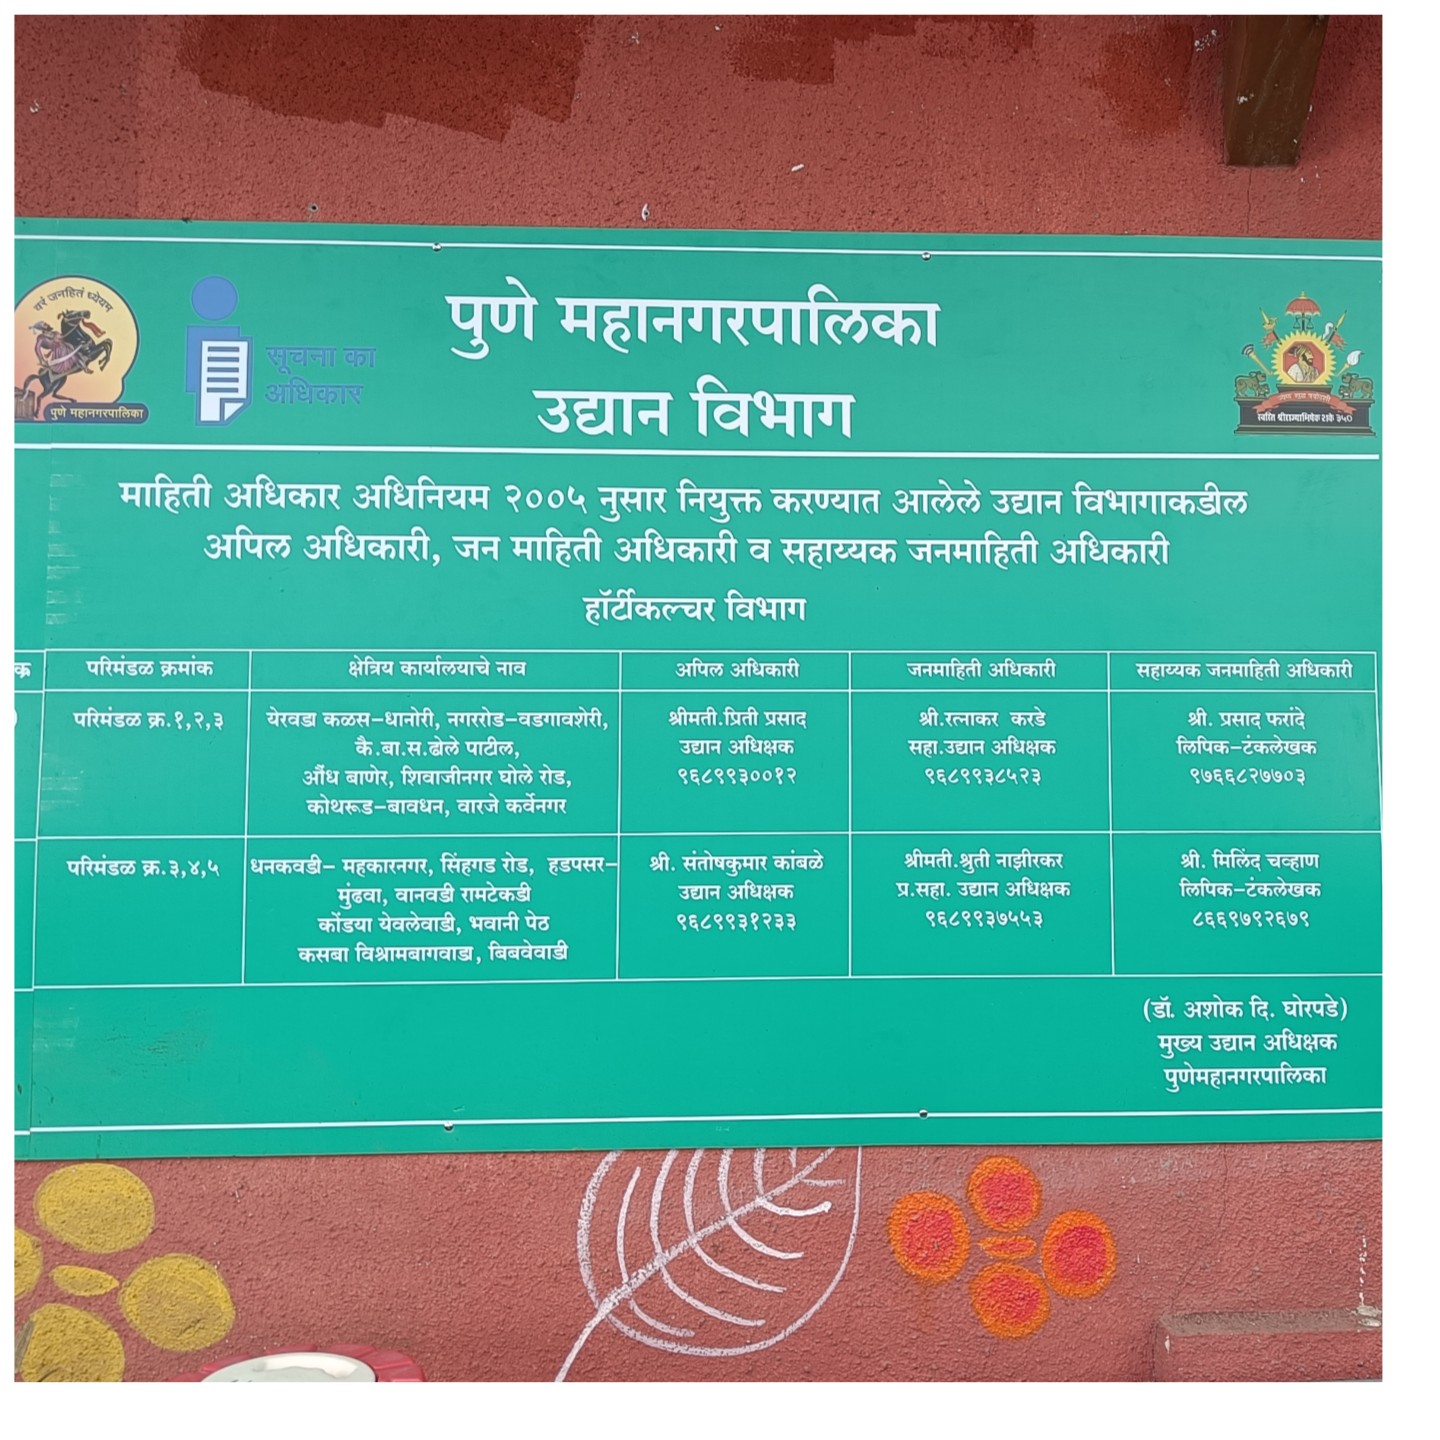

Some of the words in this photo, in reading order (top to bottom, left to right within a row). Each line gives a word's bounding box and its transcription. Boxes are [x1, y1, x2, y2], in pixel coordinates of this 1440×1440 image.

[445, 276, 539, 360] पुणे
[555, 283, 941, 354] महानगरपालिका
[265, 345, 338, 375] सूचना
[343, 346, 378, 368] का
[264, 377, 365, 405] अधिकार
[532, 390, 673, 436] उद्यान
[689, 374, 856, 438] विभाग
[117, 472, 214, 515] माहिती
[223, 472, 342, 511] अधिकार
[352, 474, 492, 511] अधिनियम
[504, 484, 588, 515] २००५
[596, 486, 668, 523] नुसार
[675, 477, 763, 524] नियुक्त
[769, 488, 882, 515] करण्यात
[891, 478, 982, 515] आलेले
[989, 489, 1064, 515] उद्यान
[1070, 480, 1249, 516] विभागाकडील
[203, 523, 293, 561] अपिल
[302, 524, 441, 568] अधिकारी,
[451, 535, 502, 562] जन
[509, 526, 604, 569] माहिती
[613, 527, 739, 565] अधिकारी
[745, 537, 773, 564] व
[779, 538, 899, 570] सहाय्यक
[905, 529, 1040, 571] जनमाहिती
[1049, 529, 1171, 566] अधिकारी
[581, 587, 717, 627] हॉर्टीकल्चर
[723, 588, 808, 622] विभाग
[85, 654, 155, 677] परिमंडळ
[158, 654, 215, 678] क्रमांक
[494, 660, 528, 677] नाव
[674, 656, 725, 678] अपिल
[729, 656, 801, 679] अधिकारी
[906, 657, 983, 681] जनमाहिती
[987, 657, 1057, 679] अधिकारी
[1135, 662, 1202, 682] सहाय्यक
[1204, 657, 1281, 682] जनमाहिती
[1285, 657, 1354, 679] अधिकारी
[72, 705, 143, 729] परिमंडळ
[762, 710, 808, 730] प्रसाद
[1008, 705, 1047, 728] करडे
[1187, 706, 1213, 727] श्री.
[1217, 711, 1262, 730] प्रसाद
[1264, 705, 1306, 730] फरांदे
[678, 739, 723, 756] उद्यान
[727, 733, 795, 757] अधिक्षक
[65, 853, 137, 878] परिमंडळ
[1142, 994, 1176, 1024] (डॉ.
[1183, 993, 1245, 1020] अशोक
[1247, 993, 1276, 1022] दि.
[1280, 992, 1348, 1022] घोरपडे)
[1156, 1034, 1204, 1060] मुख्य
[1207, 1033, 1257, 1053] उद्यान
[1262, 1027, 1339, 1054] अधिक्षक
